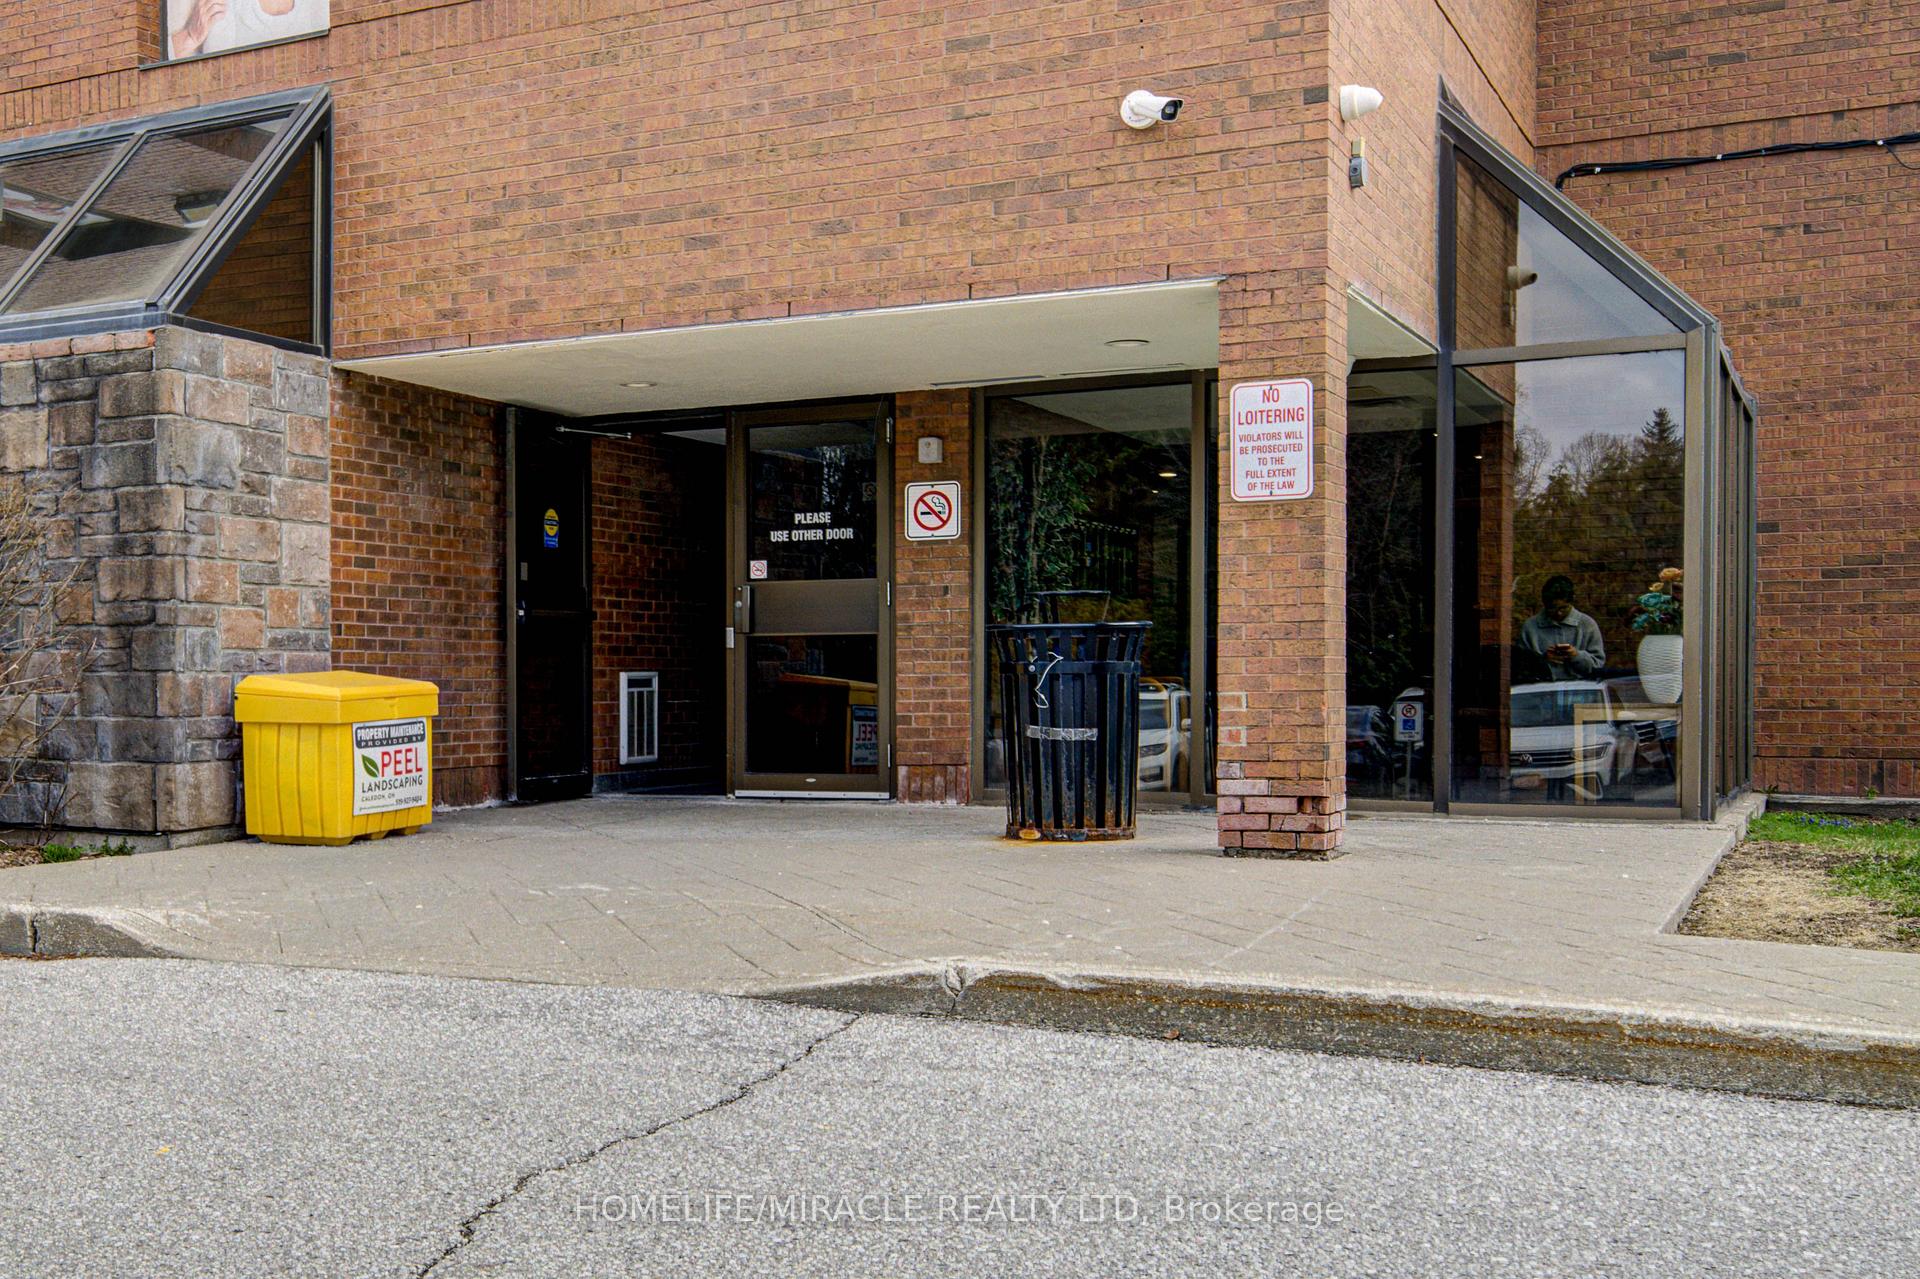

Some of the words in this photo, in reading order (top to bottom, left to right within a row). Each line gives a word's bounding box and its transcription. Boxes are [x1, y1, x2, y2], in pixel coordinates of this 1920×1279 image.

[1262, 388, 1280, 403] NO
[1238, 407, 1304, 425] LOITERING
[1238, 432, 1281, 443] VIOLATORS
[1284, 430, 1304, 440] WILL
[1239, 446, 1249, 455] BE
[1251, 443, 1303, 454] PROSECUTED
[1258, 458, 1267, 466] TO
[1270, 456, 1285, 465] THE
[1245, 470, 1265, 479] FULL
[1267, 468, 1296, 478] EXTENT
[1247, 482, 1258, 492] OF
[1260, 481, 1275, 490] THE
[1277, 480, 1295, 490] LAW
[794, 511, 831, 524] PLEASE
[770, 531, 789, 542] USE
[791, 529, 823, 541] OTHER
[826, 528, 854, 540] DOOR
[357, 727, 389, 741] PROPERTY
[390, 723, 424, 738] MAINTENANCE
[361, 739, 407, 747] PROVIDED
[381, 747, 423, 777] PEEL
[361, 775, 423, 793] LANDSCAPING
